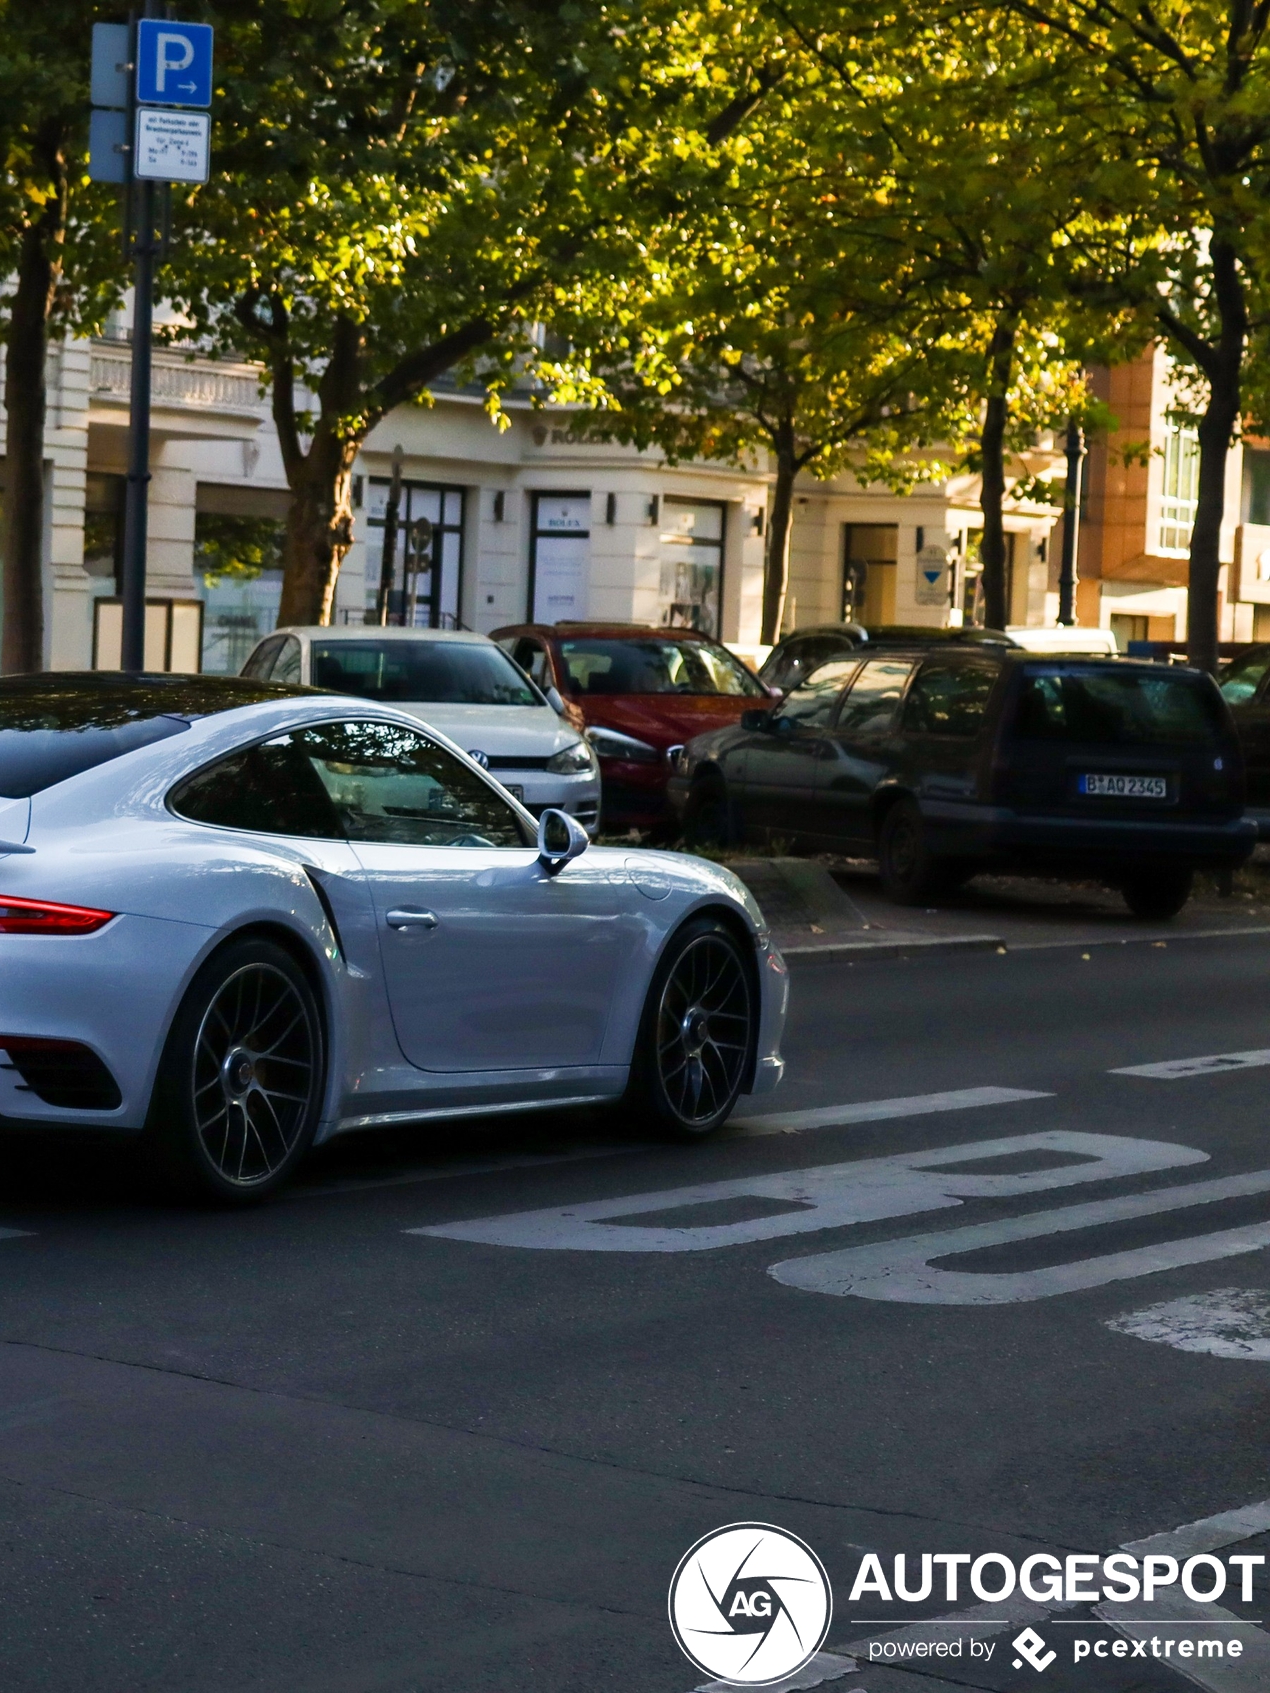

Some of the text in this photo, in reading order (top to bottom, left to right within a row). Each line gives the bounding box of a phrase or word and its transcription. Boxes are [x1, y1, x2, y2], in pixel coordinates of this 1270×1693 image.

[156, 32, 194, 92] P
[1088, 776, 1096, 791] B
[1129, 778, 1163, 795] 2345
